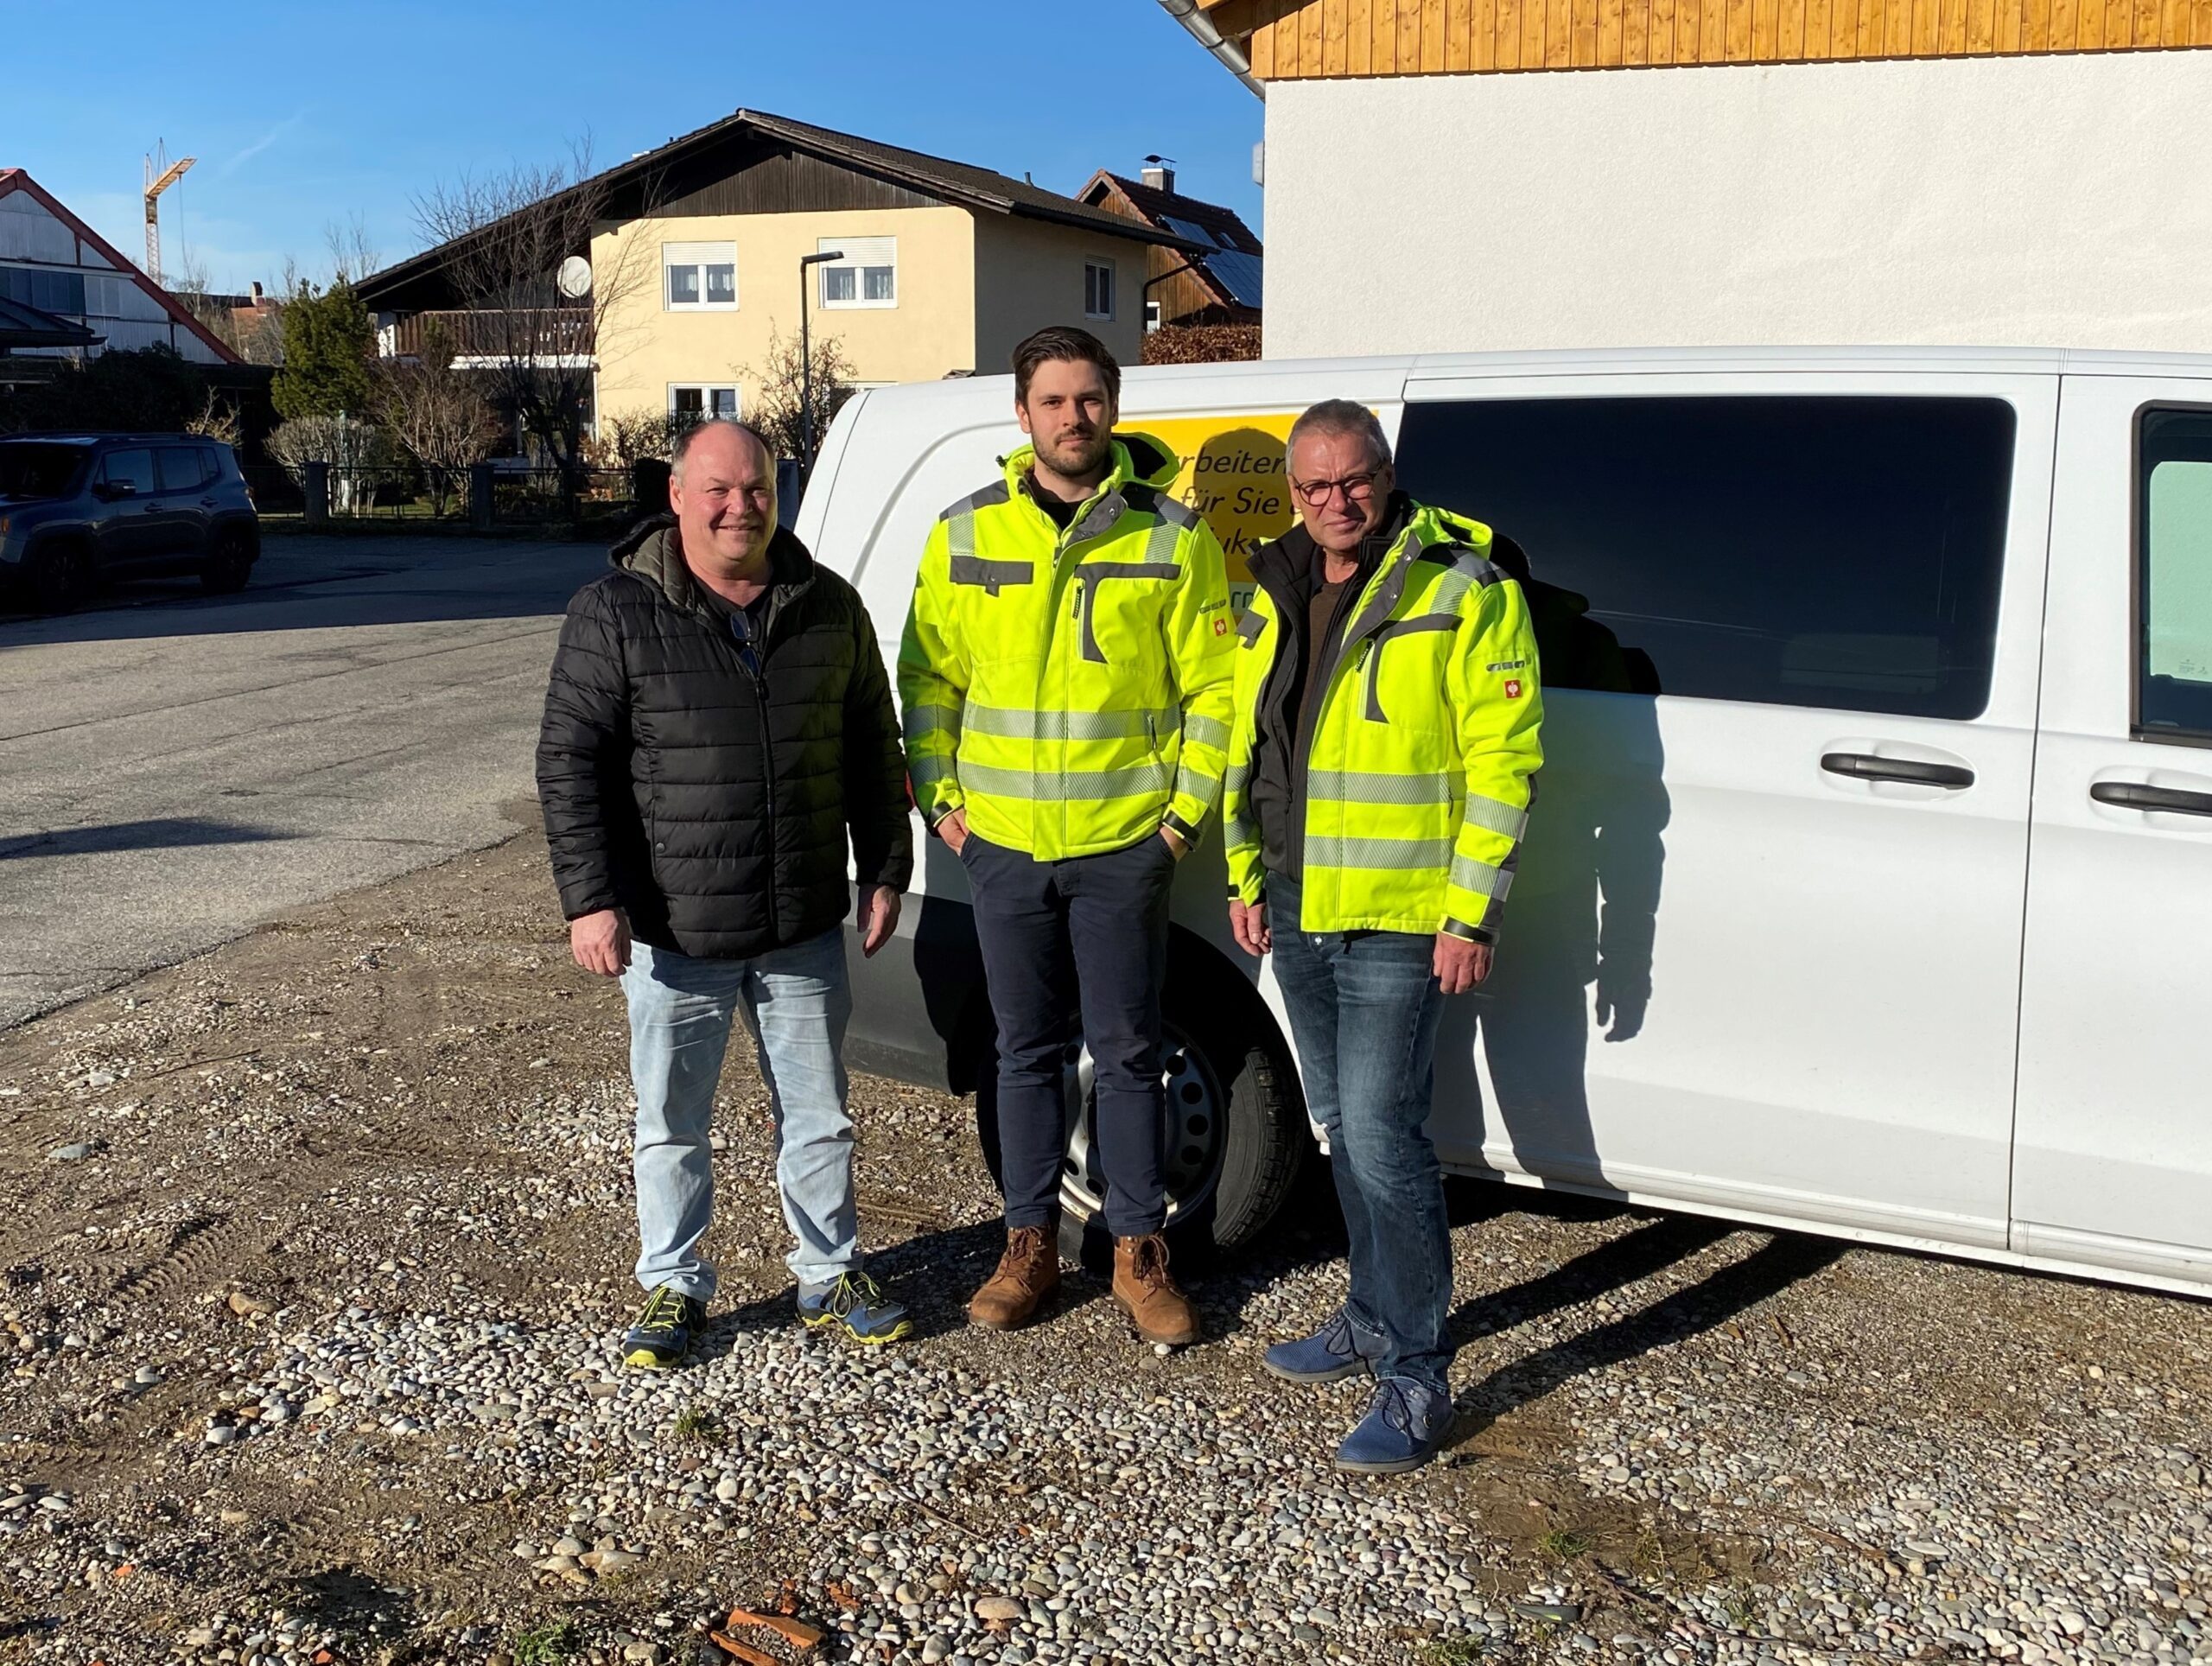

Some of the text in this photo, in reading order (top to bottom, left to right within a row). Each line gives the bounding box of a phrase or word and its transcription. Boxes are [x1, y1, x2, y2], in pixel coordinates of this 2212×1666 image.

[1175, 447, 1287, 474] rbeiten
[1181, 486, 1225, 512] für
[1233, 486, 1280, 514] Sie
